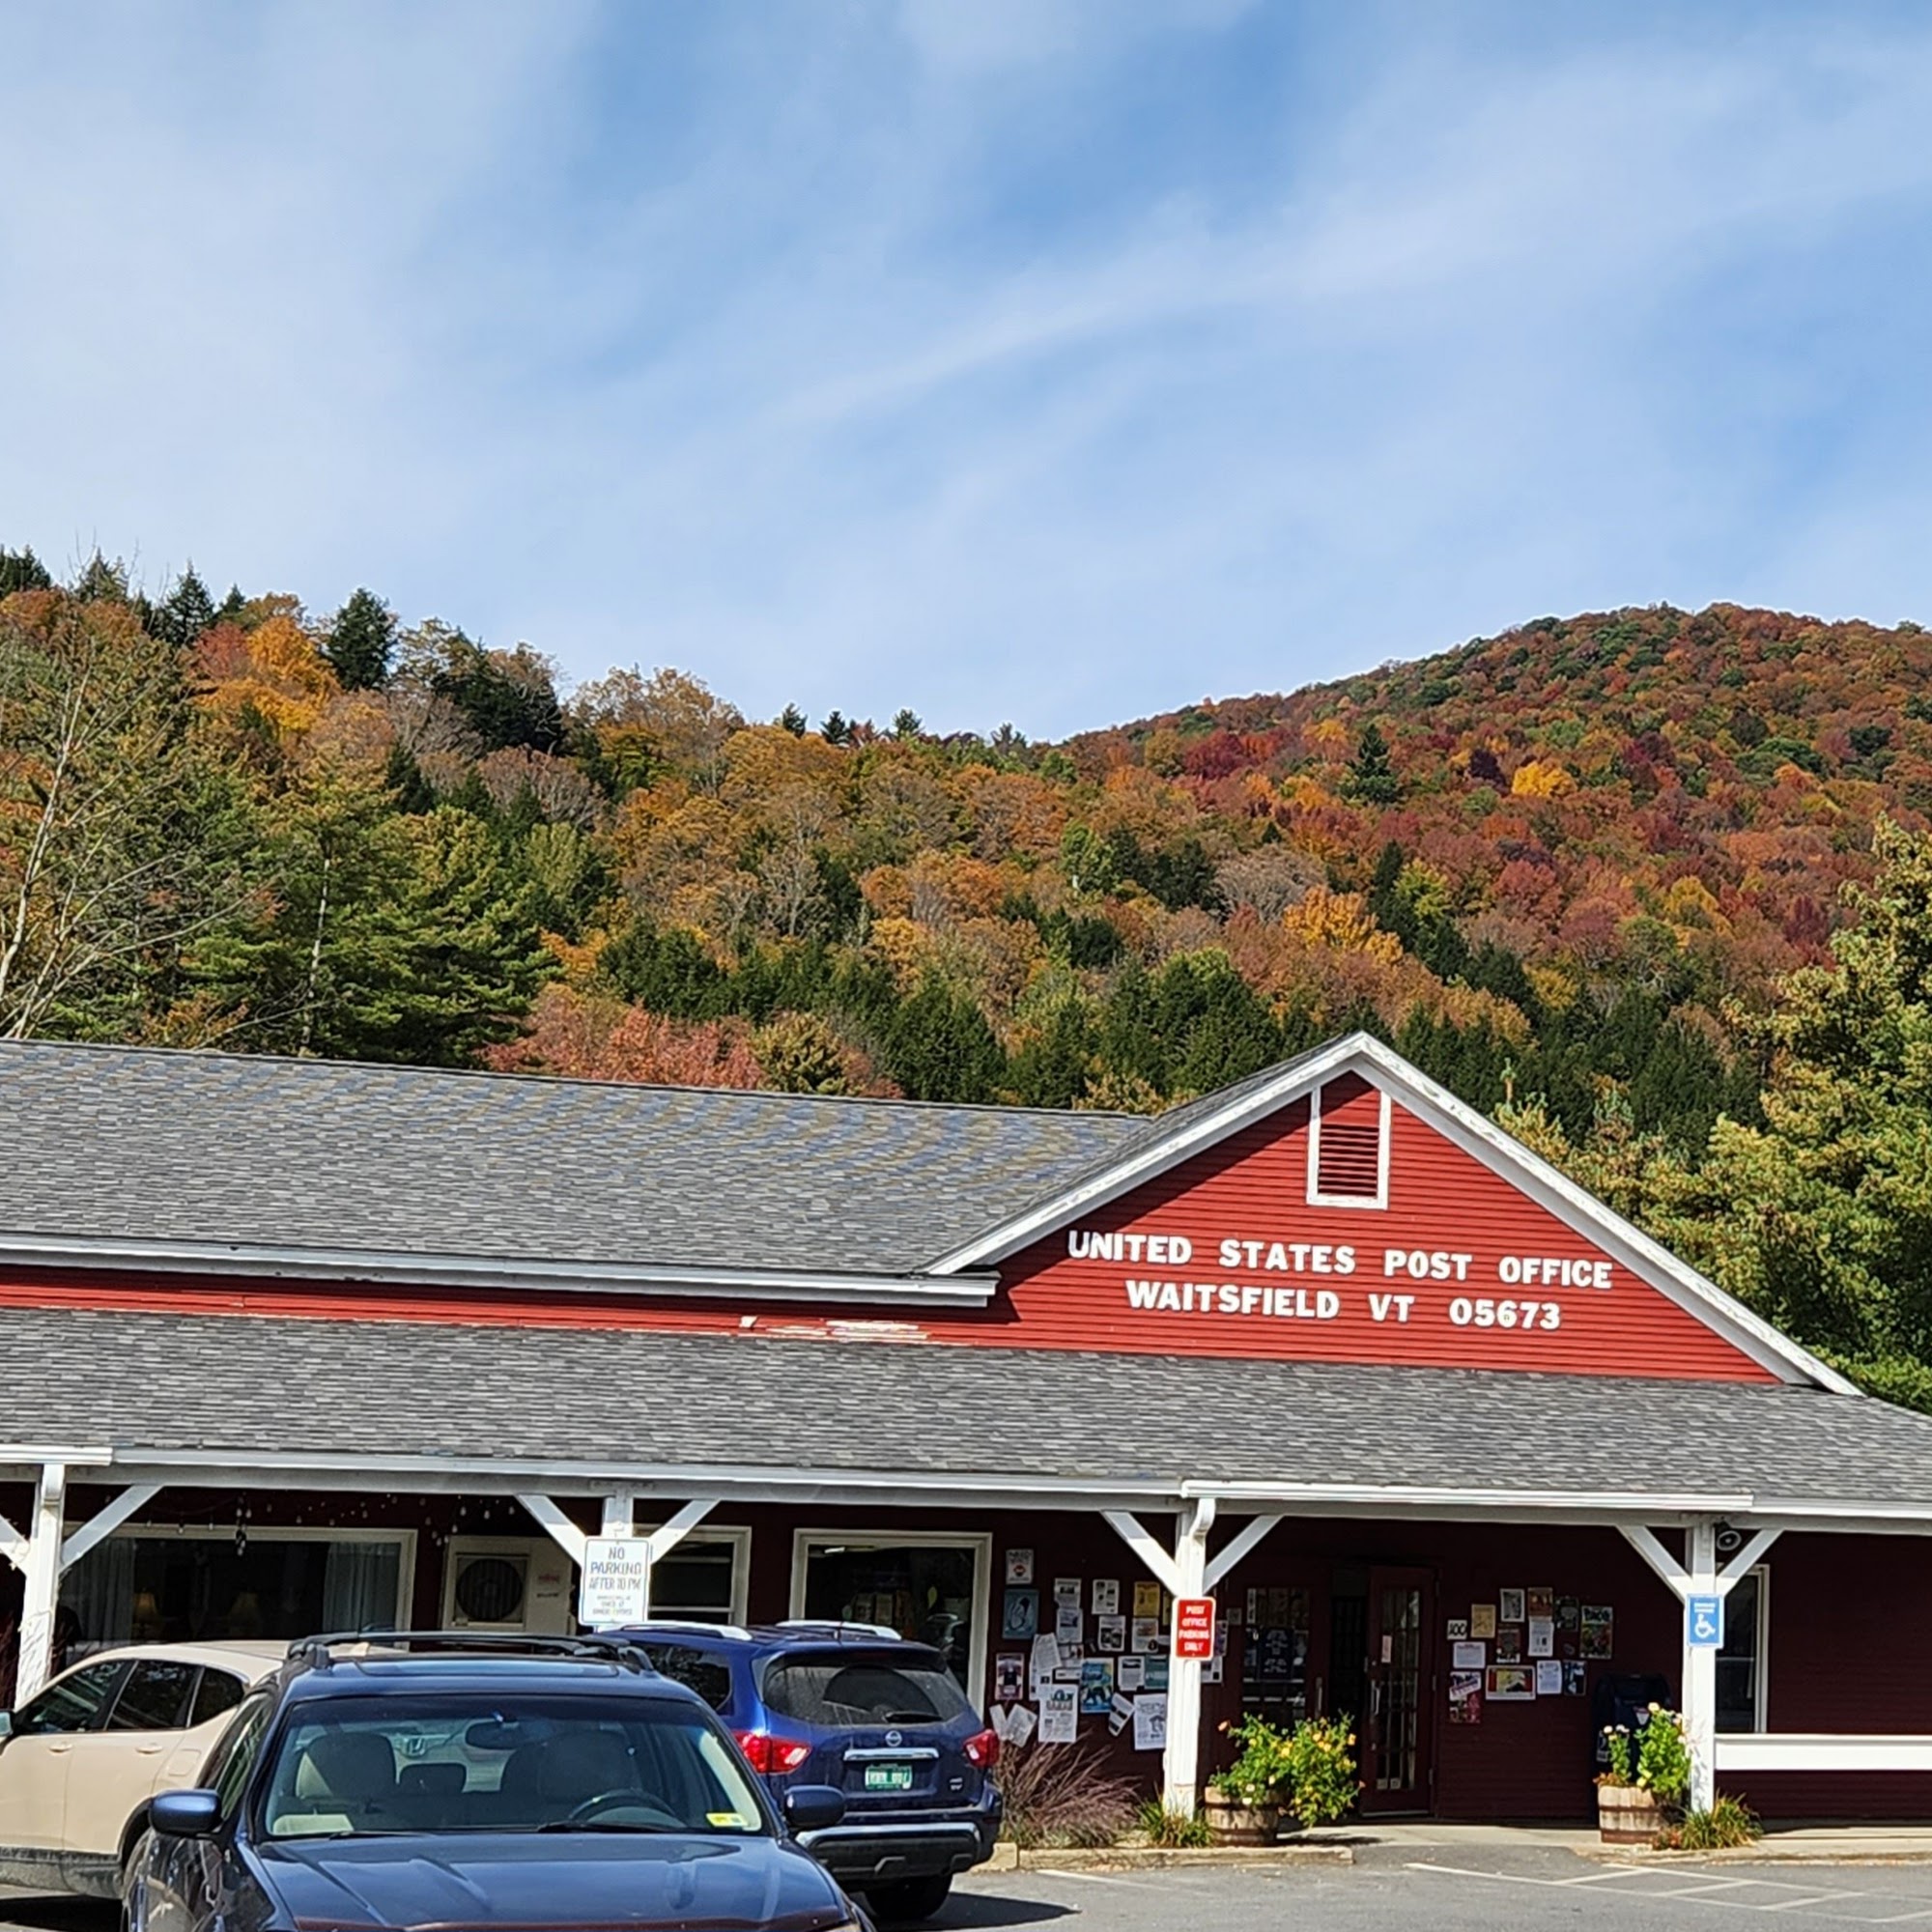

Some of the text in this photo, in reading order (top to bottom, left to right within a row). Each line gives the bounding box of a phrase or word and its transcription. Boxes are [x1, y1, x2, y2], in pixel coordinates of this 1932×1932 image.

[1067, 1230, 1613, 1290] UNITED STATES POST OFFICE
[1124, 1280, 1562, 1330] WAITSFIELD VT 05673
[590, 1561, 642, 1576] PARKING
[608, 1546, 625, 1560] NO
